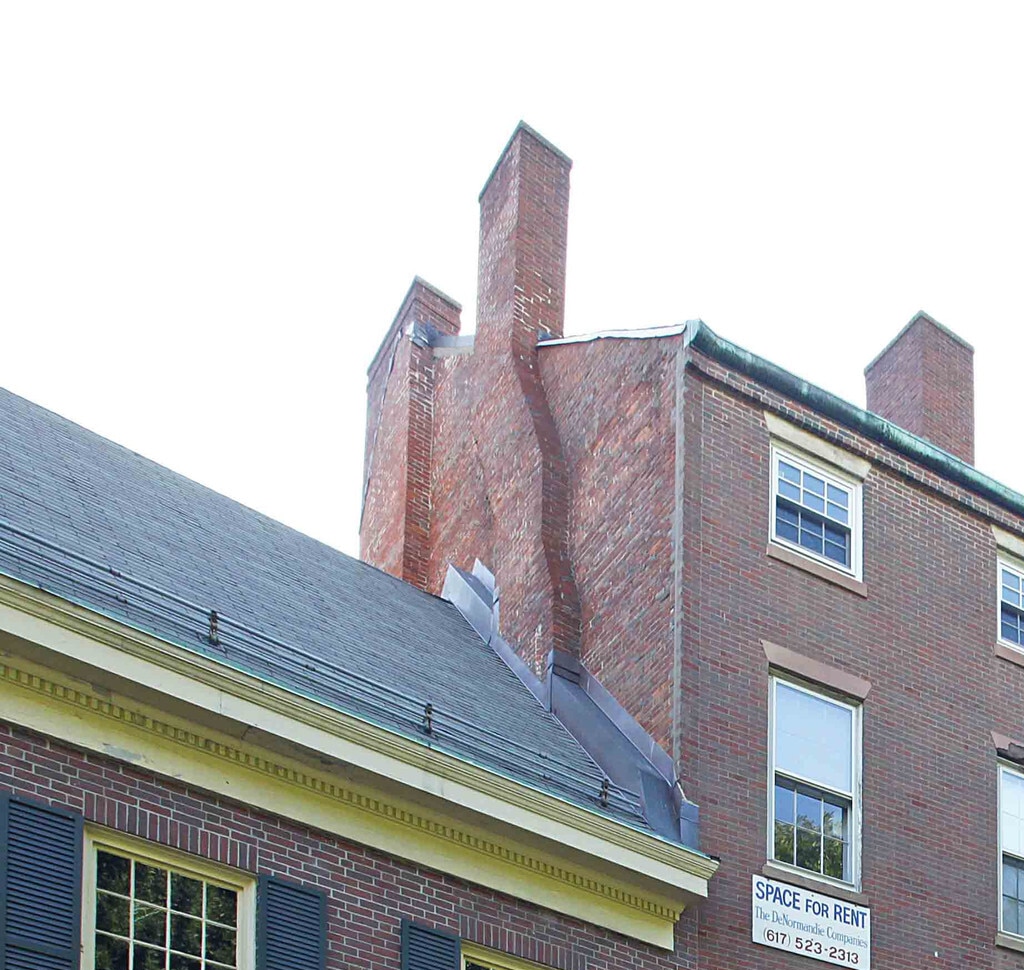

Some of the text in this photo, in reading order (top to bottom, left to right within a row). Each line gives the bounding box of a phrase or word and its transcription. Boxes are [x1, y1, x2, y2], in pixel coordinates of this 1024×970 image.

[756, 881, 867, 929] SPACE FOR RENT
[755, 906, 868, 949] The DeNormandie Companies
[763, 927, 859, 965] (617) 523-2313
